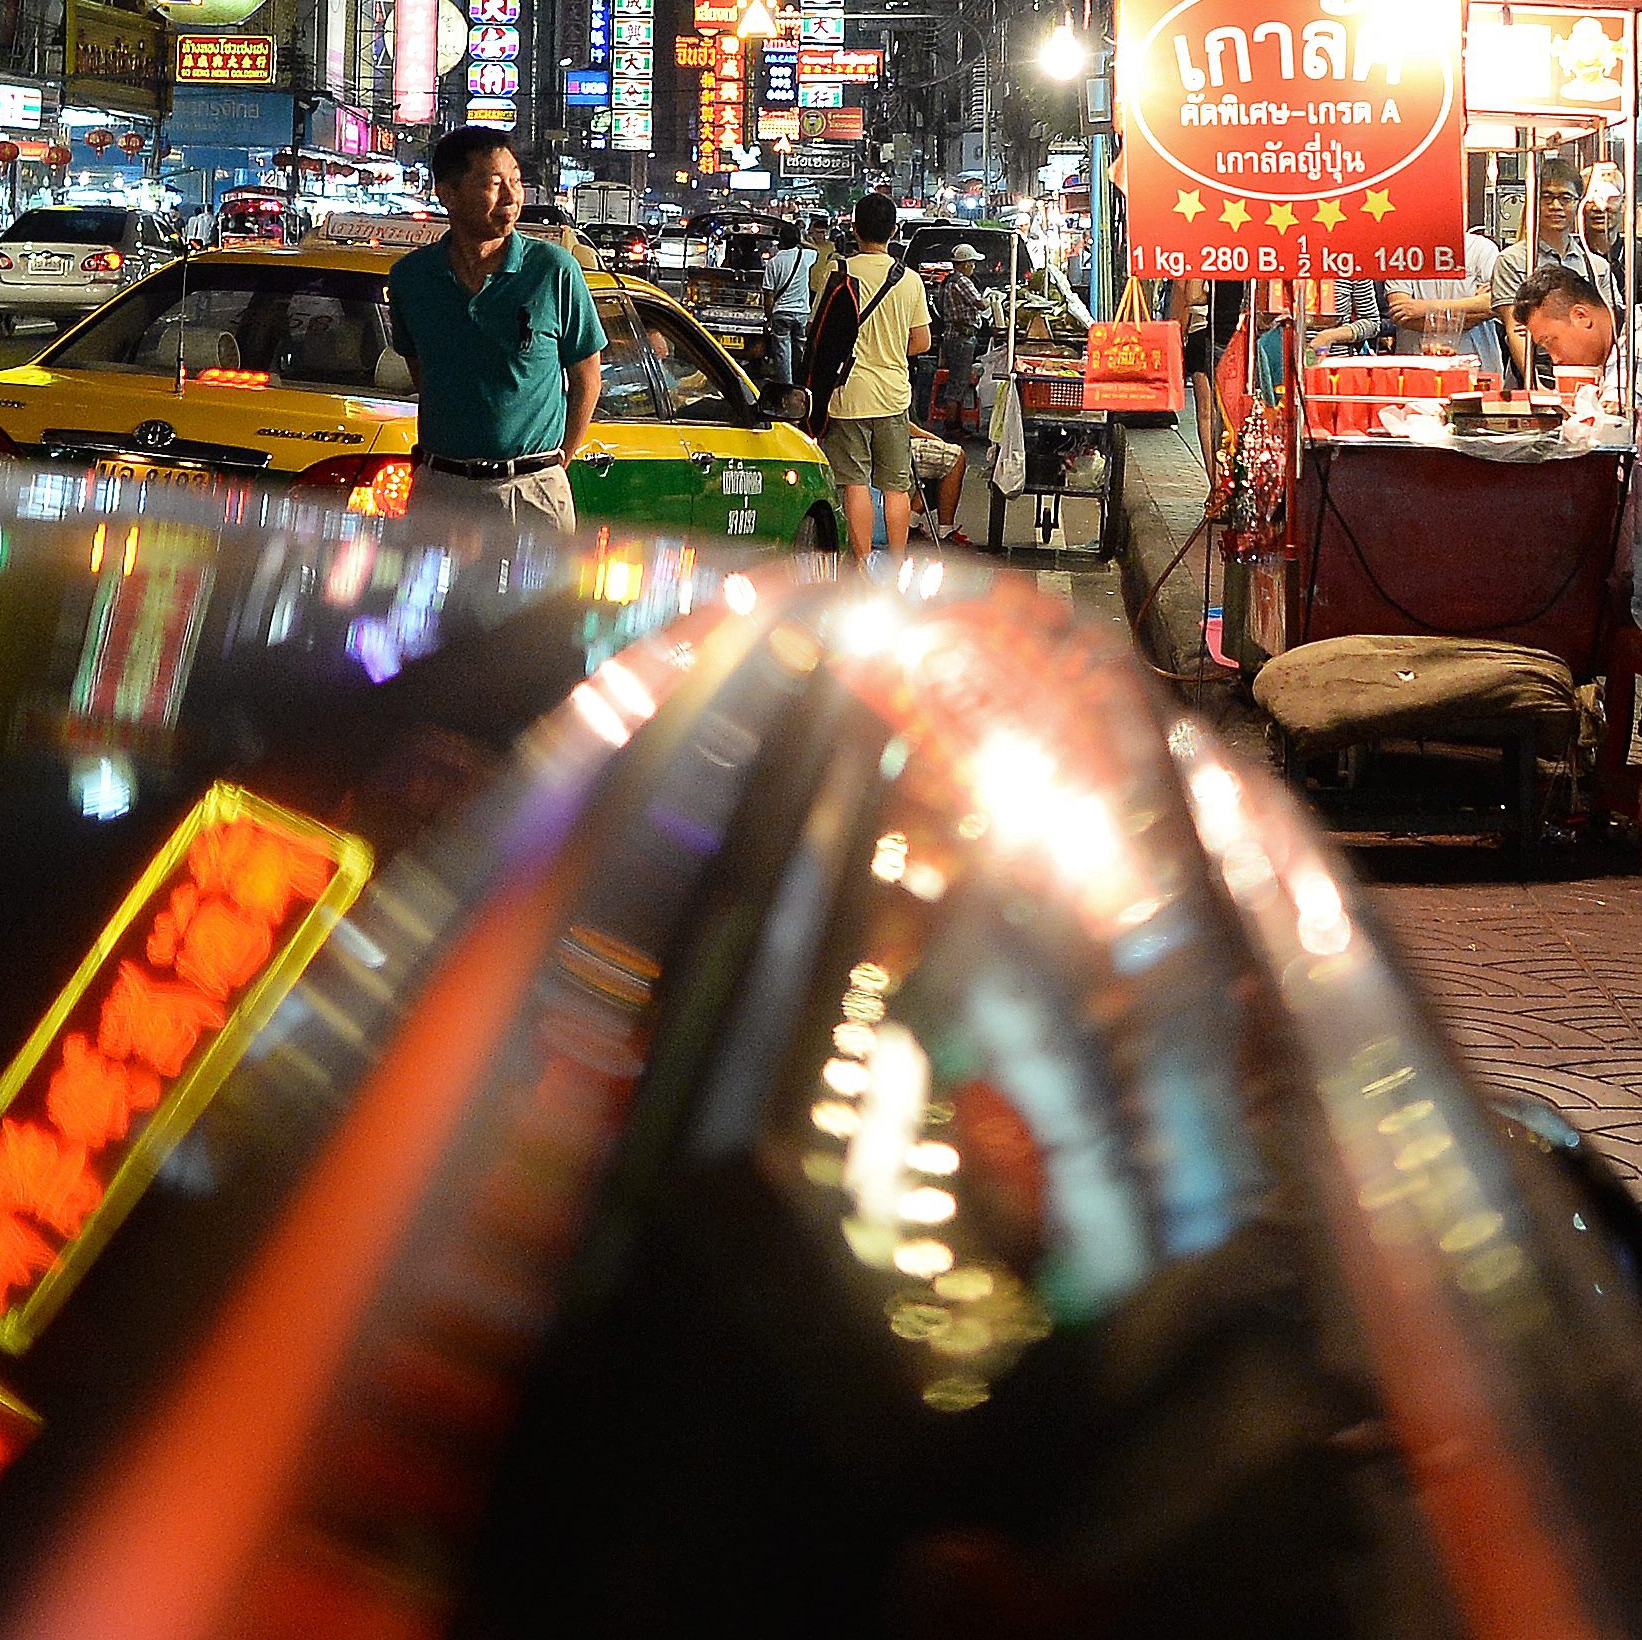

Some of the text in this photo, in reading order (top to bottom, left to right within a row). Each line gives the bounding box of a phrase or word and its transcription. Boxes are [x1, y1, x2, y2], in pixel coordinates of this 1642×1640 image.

[1380, 102, 1401, 126] A
[1133, 248, 1144, 272] 1
[1155, 247, 1193, 278] kg.
[1201, 247, 1250, 272] 280
[1258, 247, 1285, 272] B.
[1323, 248, 1361, 279] kg.
[1374, 248, 1422, 273] 140
